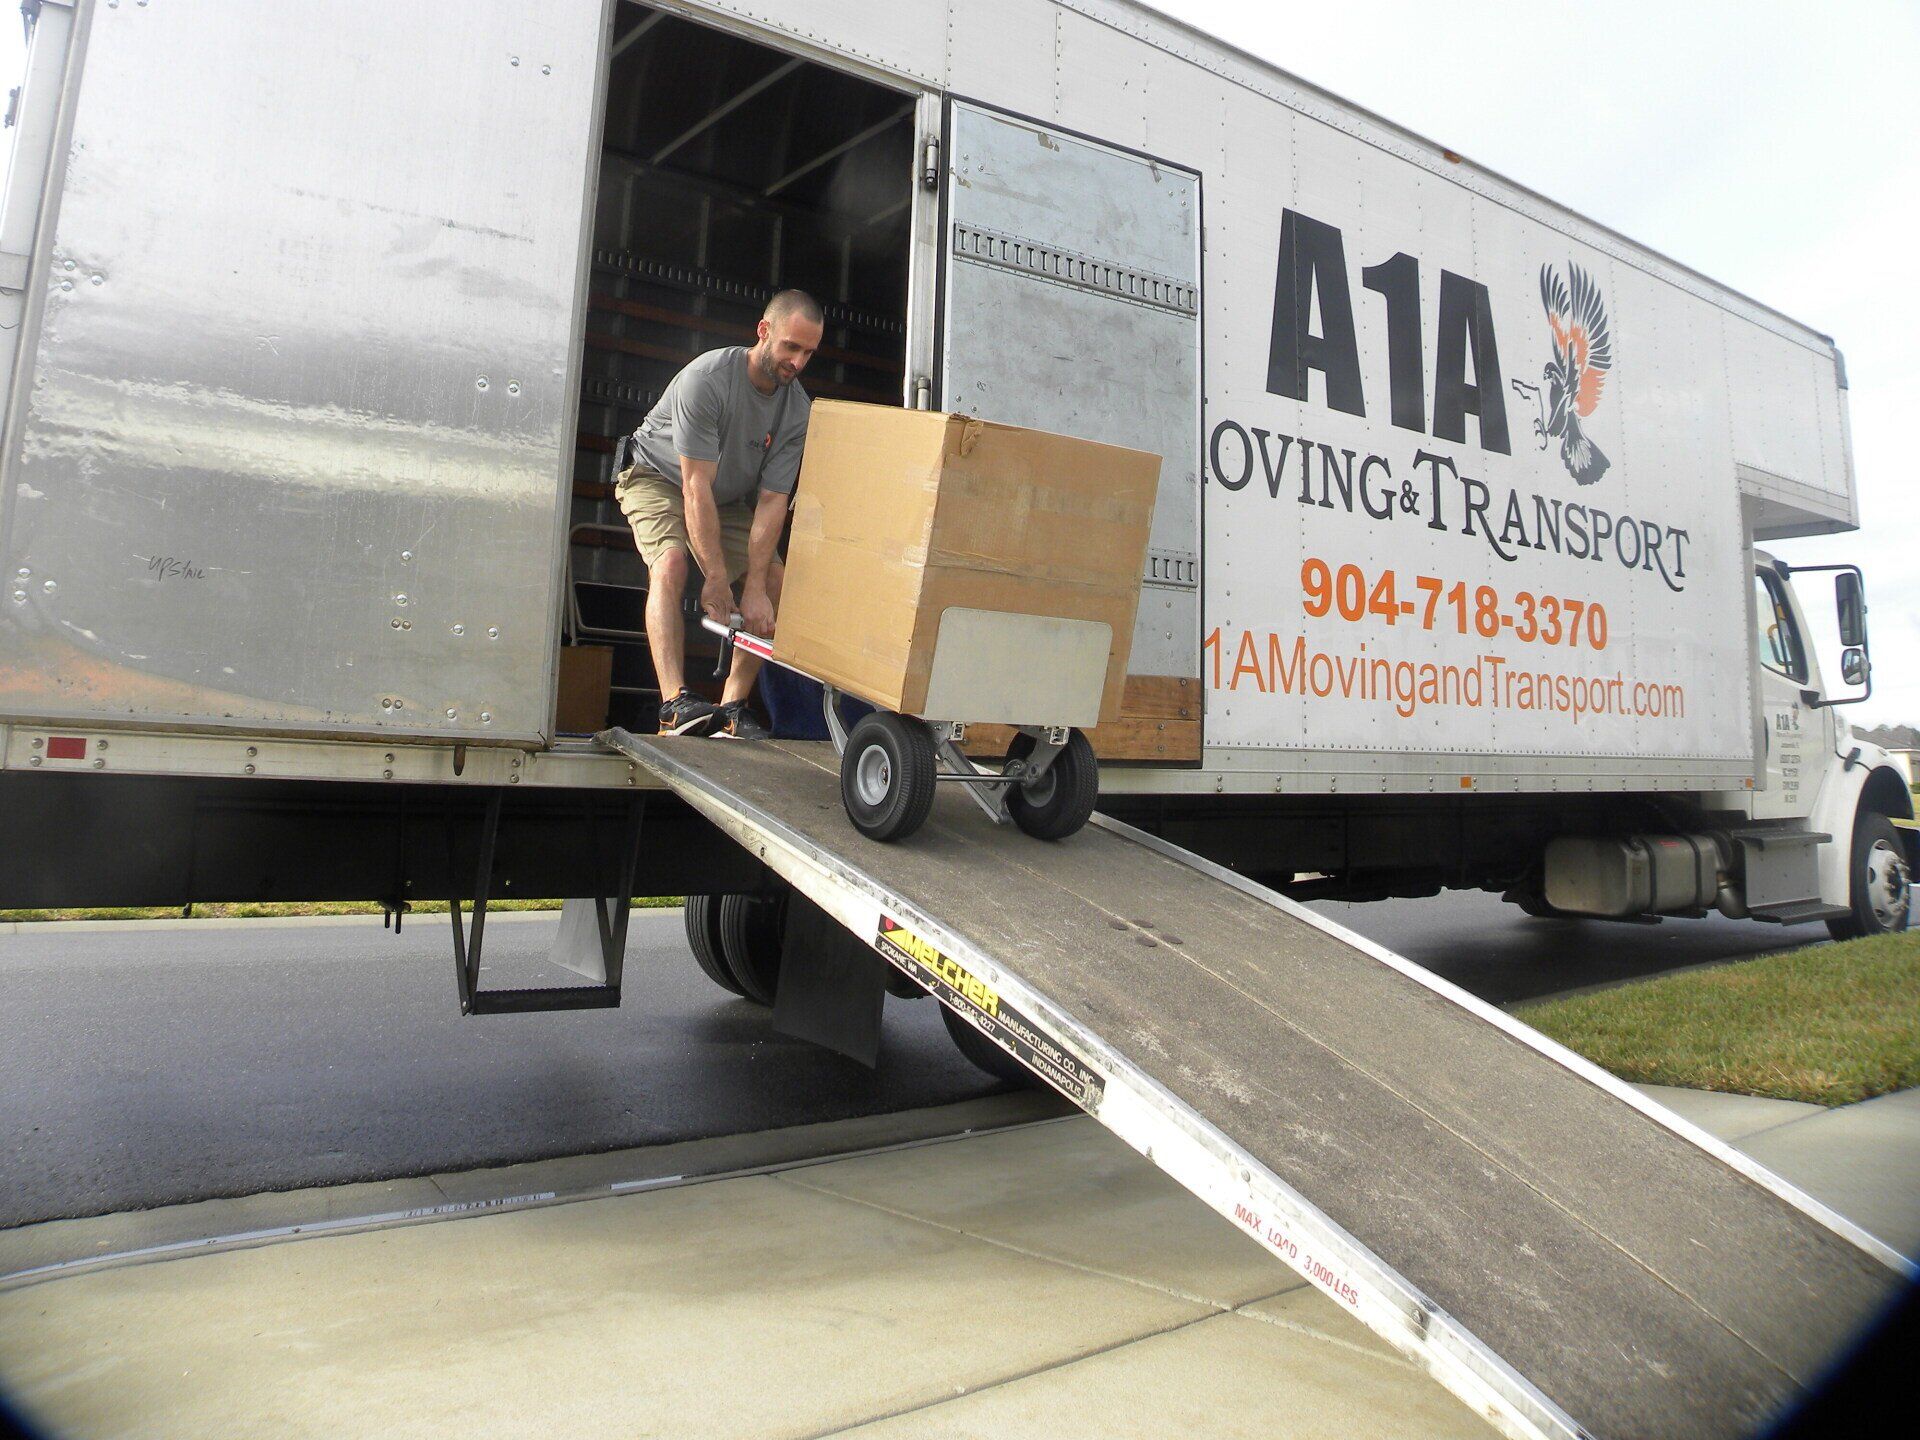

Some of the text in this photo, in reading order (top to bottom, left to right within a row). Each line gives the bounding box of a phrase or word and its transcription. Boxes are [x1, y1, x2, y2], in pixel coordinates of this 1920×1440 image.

[1266, 207, 1511, 456] A1A
[1301, 557, 1608, 651] 904-718-3370
[1203, 626, 1685, 724] 1AMovingandTransport.com
[907, 959, 918, 975] WA
[998, 1009, 1063, 1063] MANUFACTURING
[1268, 1228, 1297, 1259] LOAD
